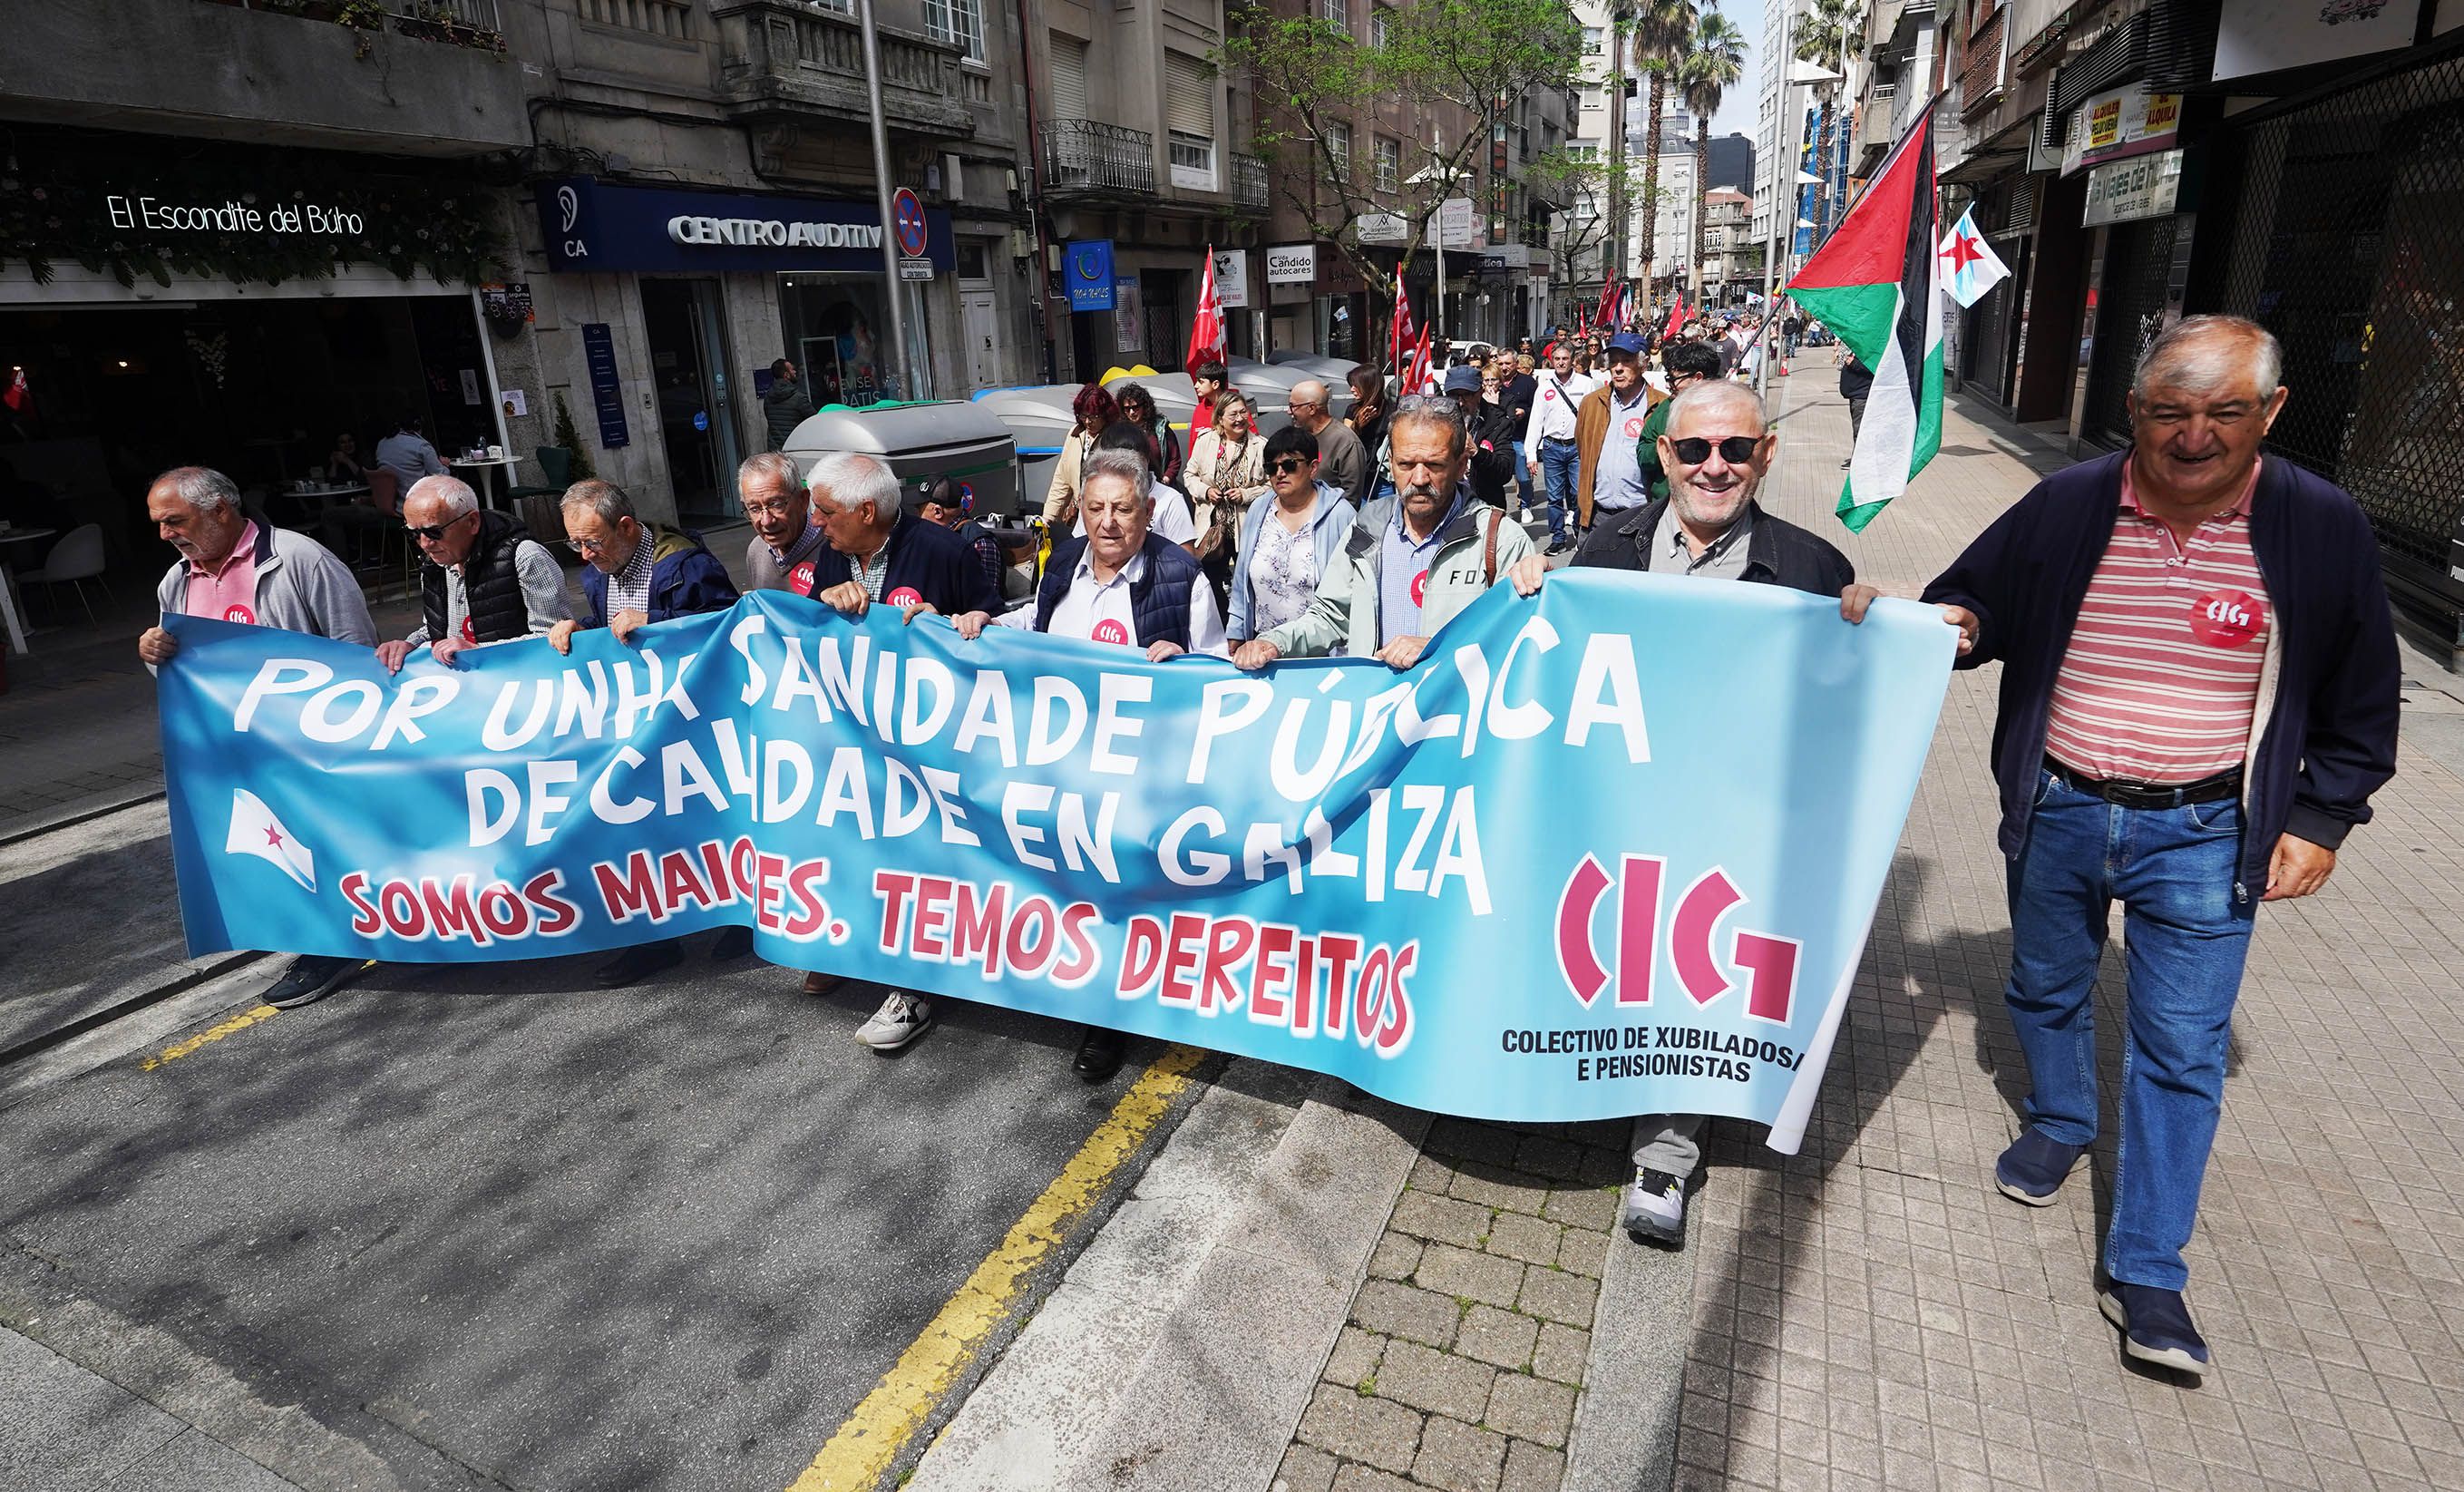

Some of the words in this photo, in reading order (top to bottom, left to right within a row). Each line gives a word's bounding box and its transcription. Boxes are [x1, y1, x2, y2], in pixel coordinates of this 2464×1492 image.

[2146, 104, 2177, 126] ALQUILA
[2131, 160, 2145, 192] de
[107, 195, 134, 229] El
[140, 197, 264, 232] Escondite
[269, 203, 302, 233] del
[307, 205, 363, 234] Búho
[667, 215, 787, 247] CENTRO
[786, 221, 882, 249] AUDITIV
[564, 239, 589, 257] CA
[1270, 256, 1311, 268] Candido
[1270, 267, 1311, 276] autocares
[2206, 600, 2250, 627] CIG
[1100, 625, 1121, 643] CIG
[234, 658, 461, 751] POR
[729, 614, 1154, 775] SANIDADE
[1185, 615, 1651, 802] PÚBLICA
[464, 760, 578, 847] DE
[588, 717, 980, 848] CALIDADE
[1001, 781, 1121, 883] EN
[1157, 785, 1492, 916] GALIZA
[1555, 853, 1801, 1027] CIG
[339, 868, 579, 947] SOMOS
[874, 870, 1099, 983] TEMOS
[1117, 912, 1417, 1052] DEREITOS
[1502, 1028, 1618, 1054] COLECTIVO
[1623, 1026, 1649, 1049] DE
[1577, 1058, 1590, 1082] E
[1596, 1054, 1751, 1083] PENSIONISTAS
